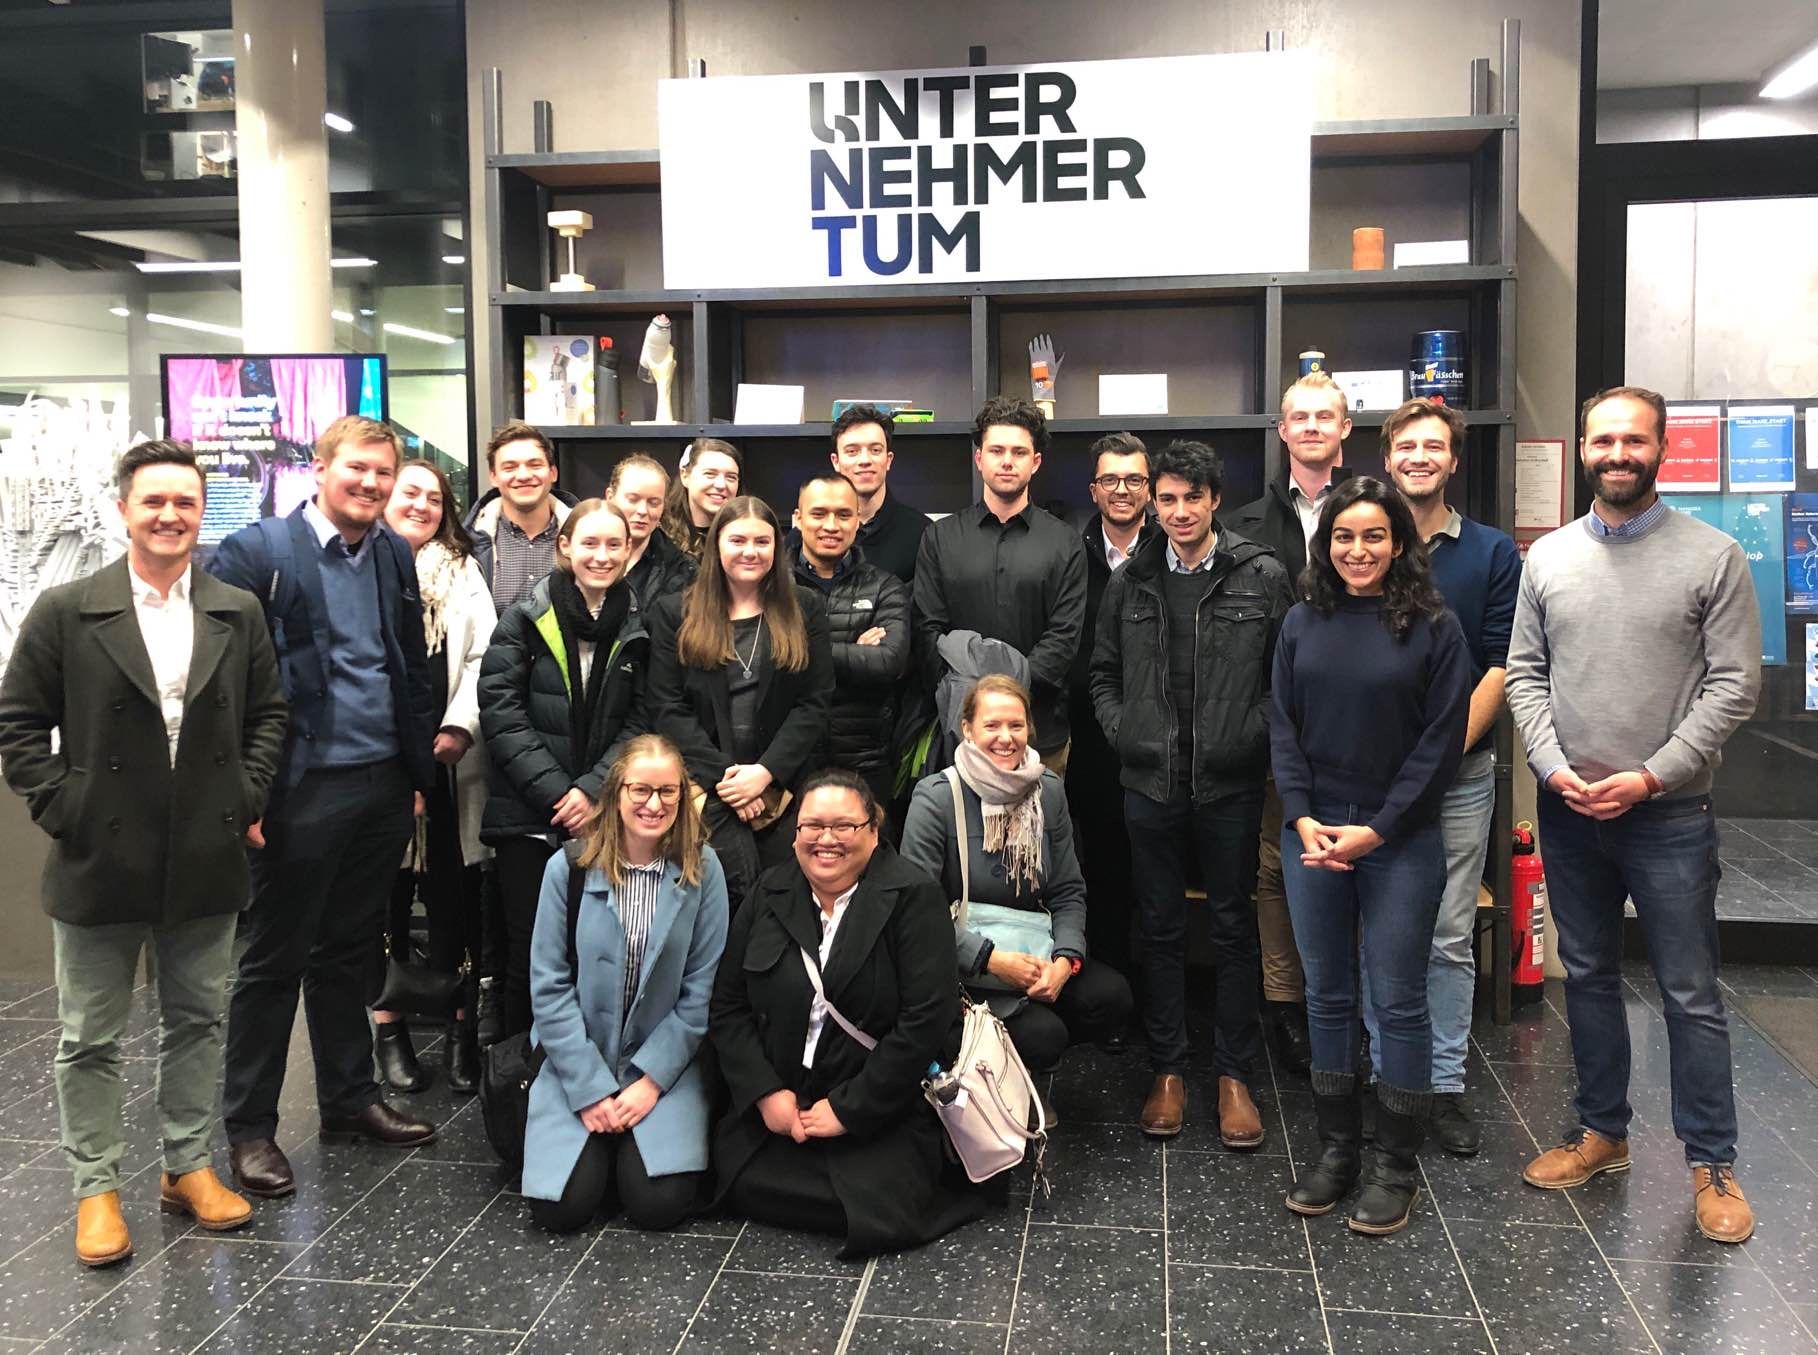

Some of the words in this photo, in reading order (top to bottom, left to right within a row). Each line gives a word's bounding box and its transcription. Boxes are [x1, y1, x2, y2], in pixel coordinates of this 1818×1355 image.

[809, 72, 1077, 143] UNTER
[811, 138, 1146, 210] NEHMER
[811, 212, 980, 276] TUM
